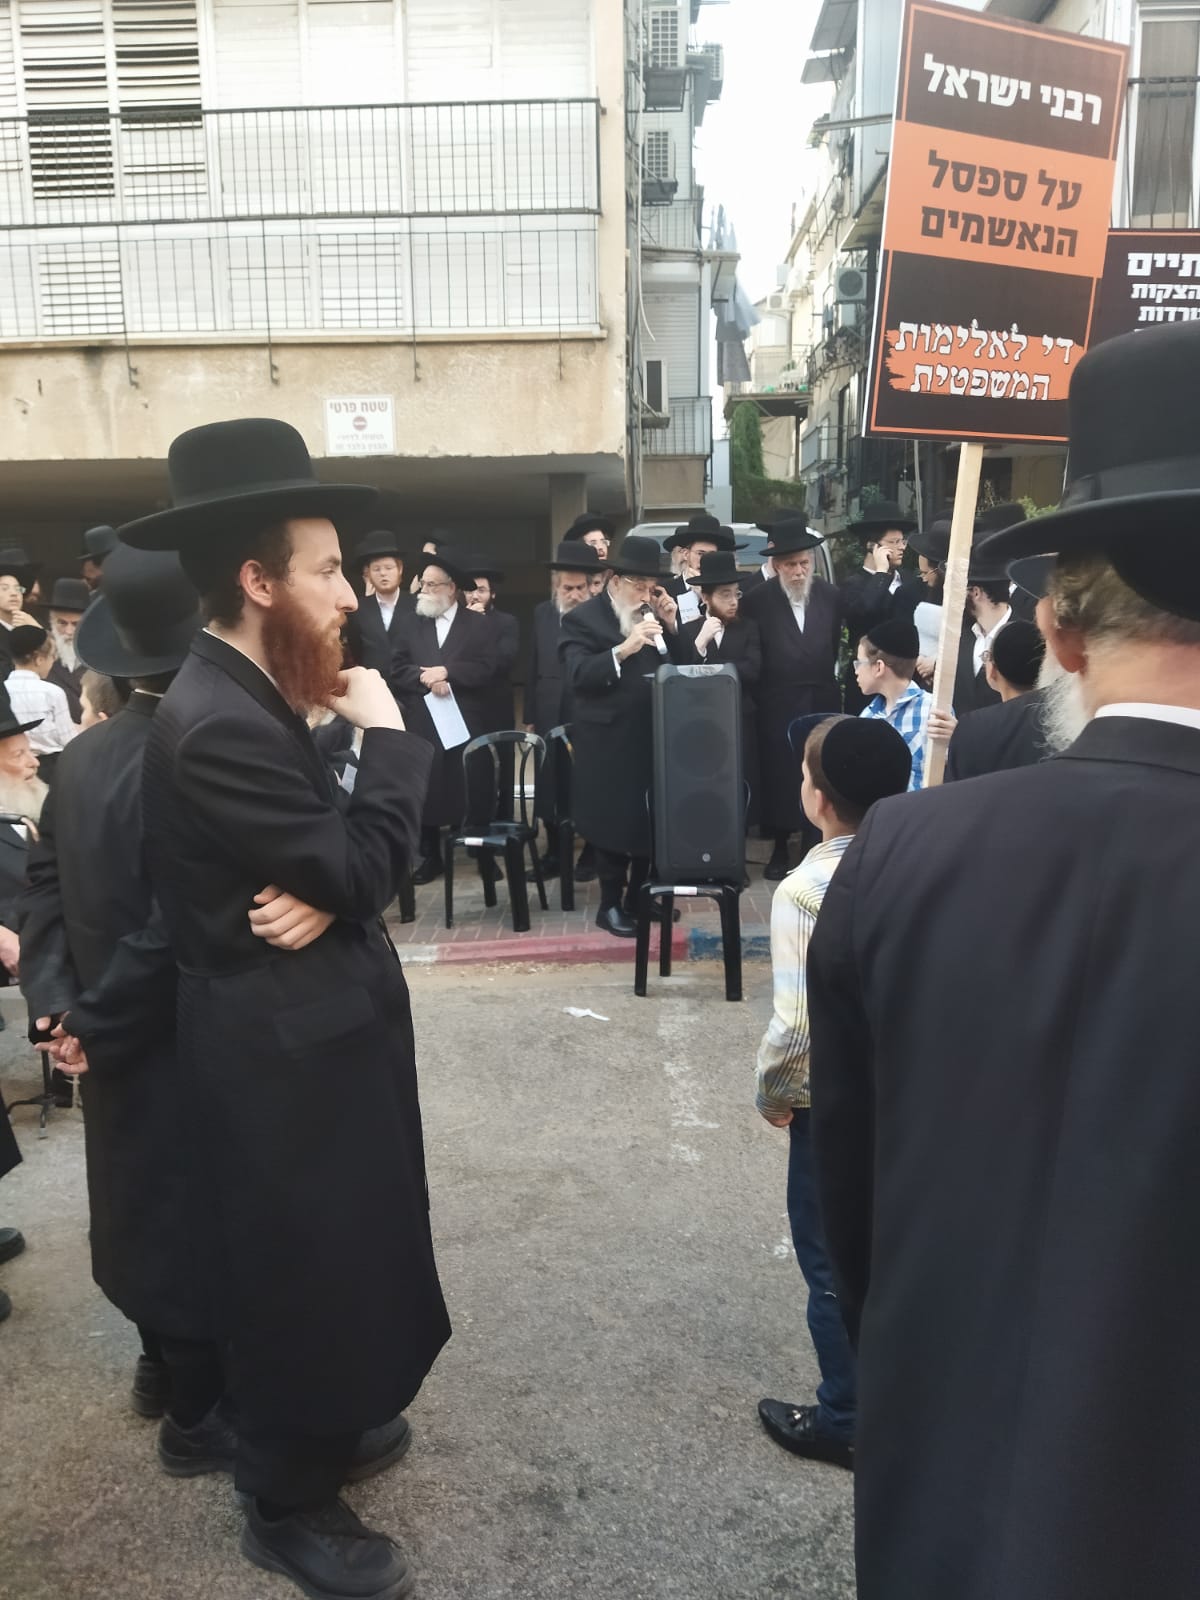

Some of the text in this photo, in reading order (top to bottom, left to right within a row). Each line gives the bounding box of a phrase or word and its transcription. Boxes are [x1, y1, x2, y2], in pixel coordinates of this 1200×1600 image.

[923, 53, 1103, 125] רבני ישראל
[927, 148, 1083, 212] על ספסל
[920, 205, 1079, 258] הנאשמים
[894, 318, 1075, 365] די לאלימות
[910, 363, 1051, 401] המשפטית
[329, 401, 388, 414] שטח פרטי
